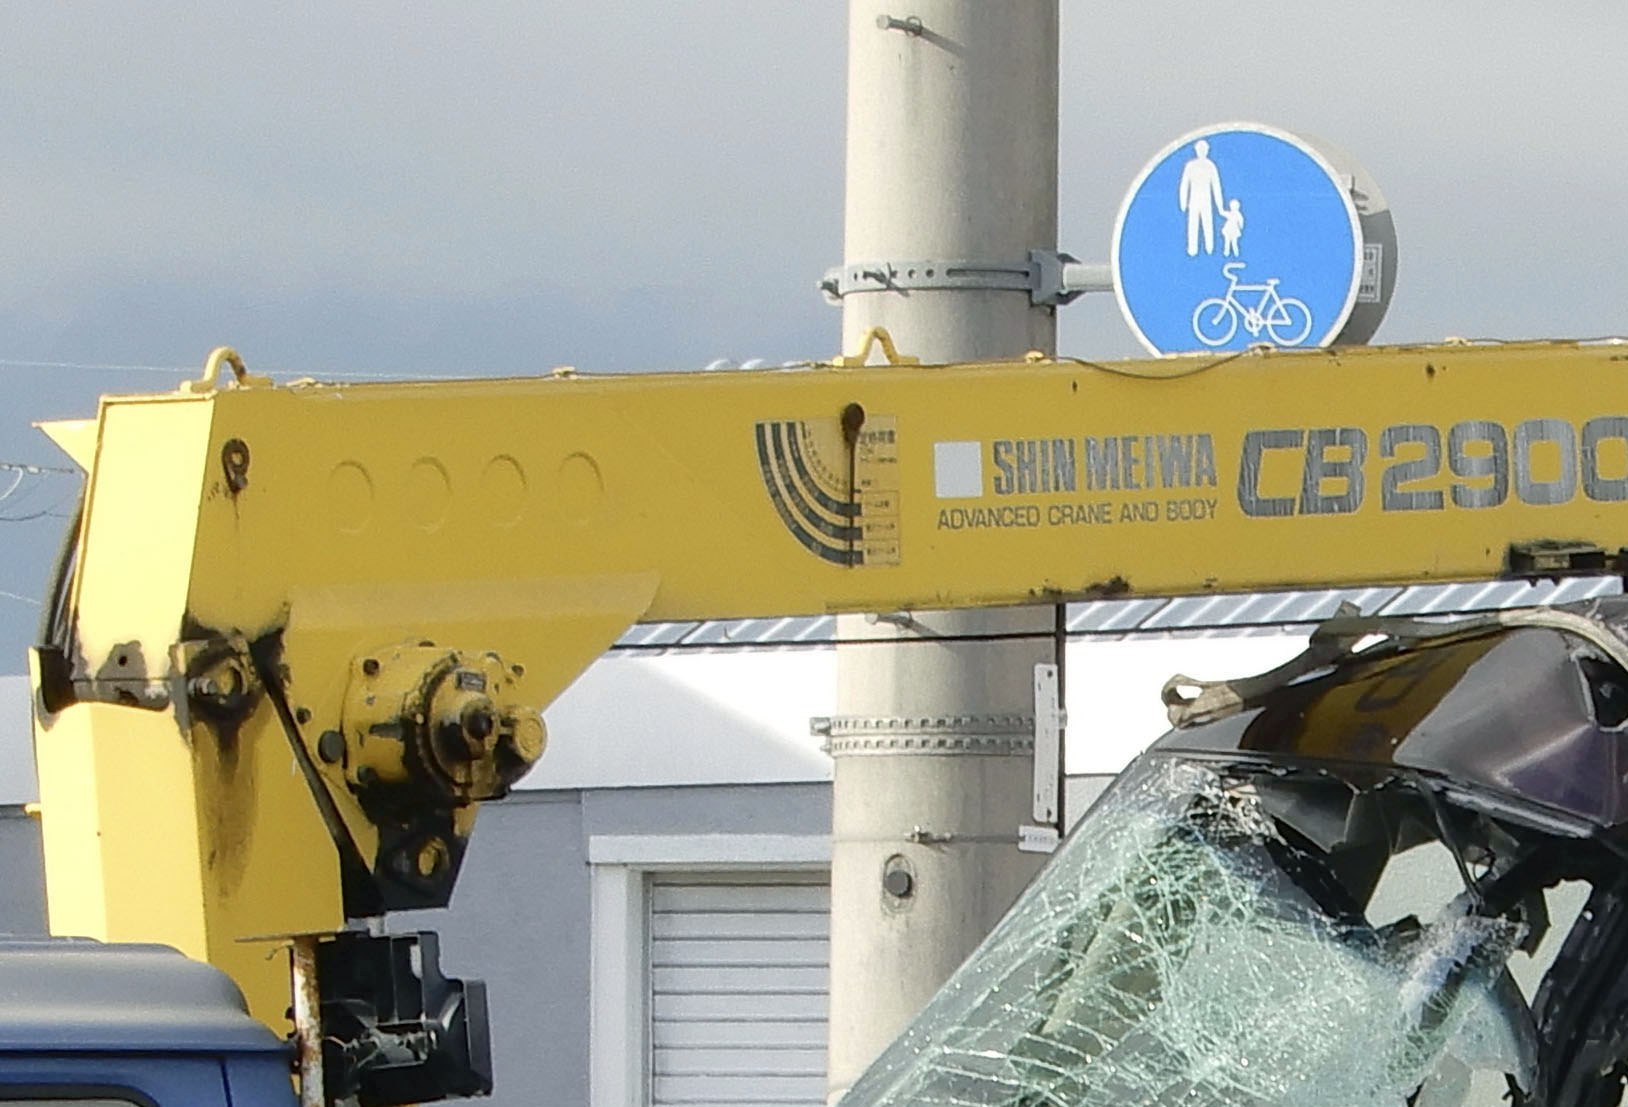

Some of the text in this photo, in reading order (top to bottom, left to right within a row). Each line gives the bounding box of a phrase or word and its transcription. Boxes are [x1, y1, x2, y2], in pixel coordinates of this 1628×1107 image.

[993, 433, 1218, 495] SHIN MEIWA
[937, 498, 1218, 530] ADVANCED CRANE AND BODY
